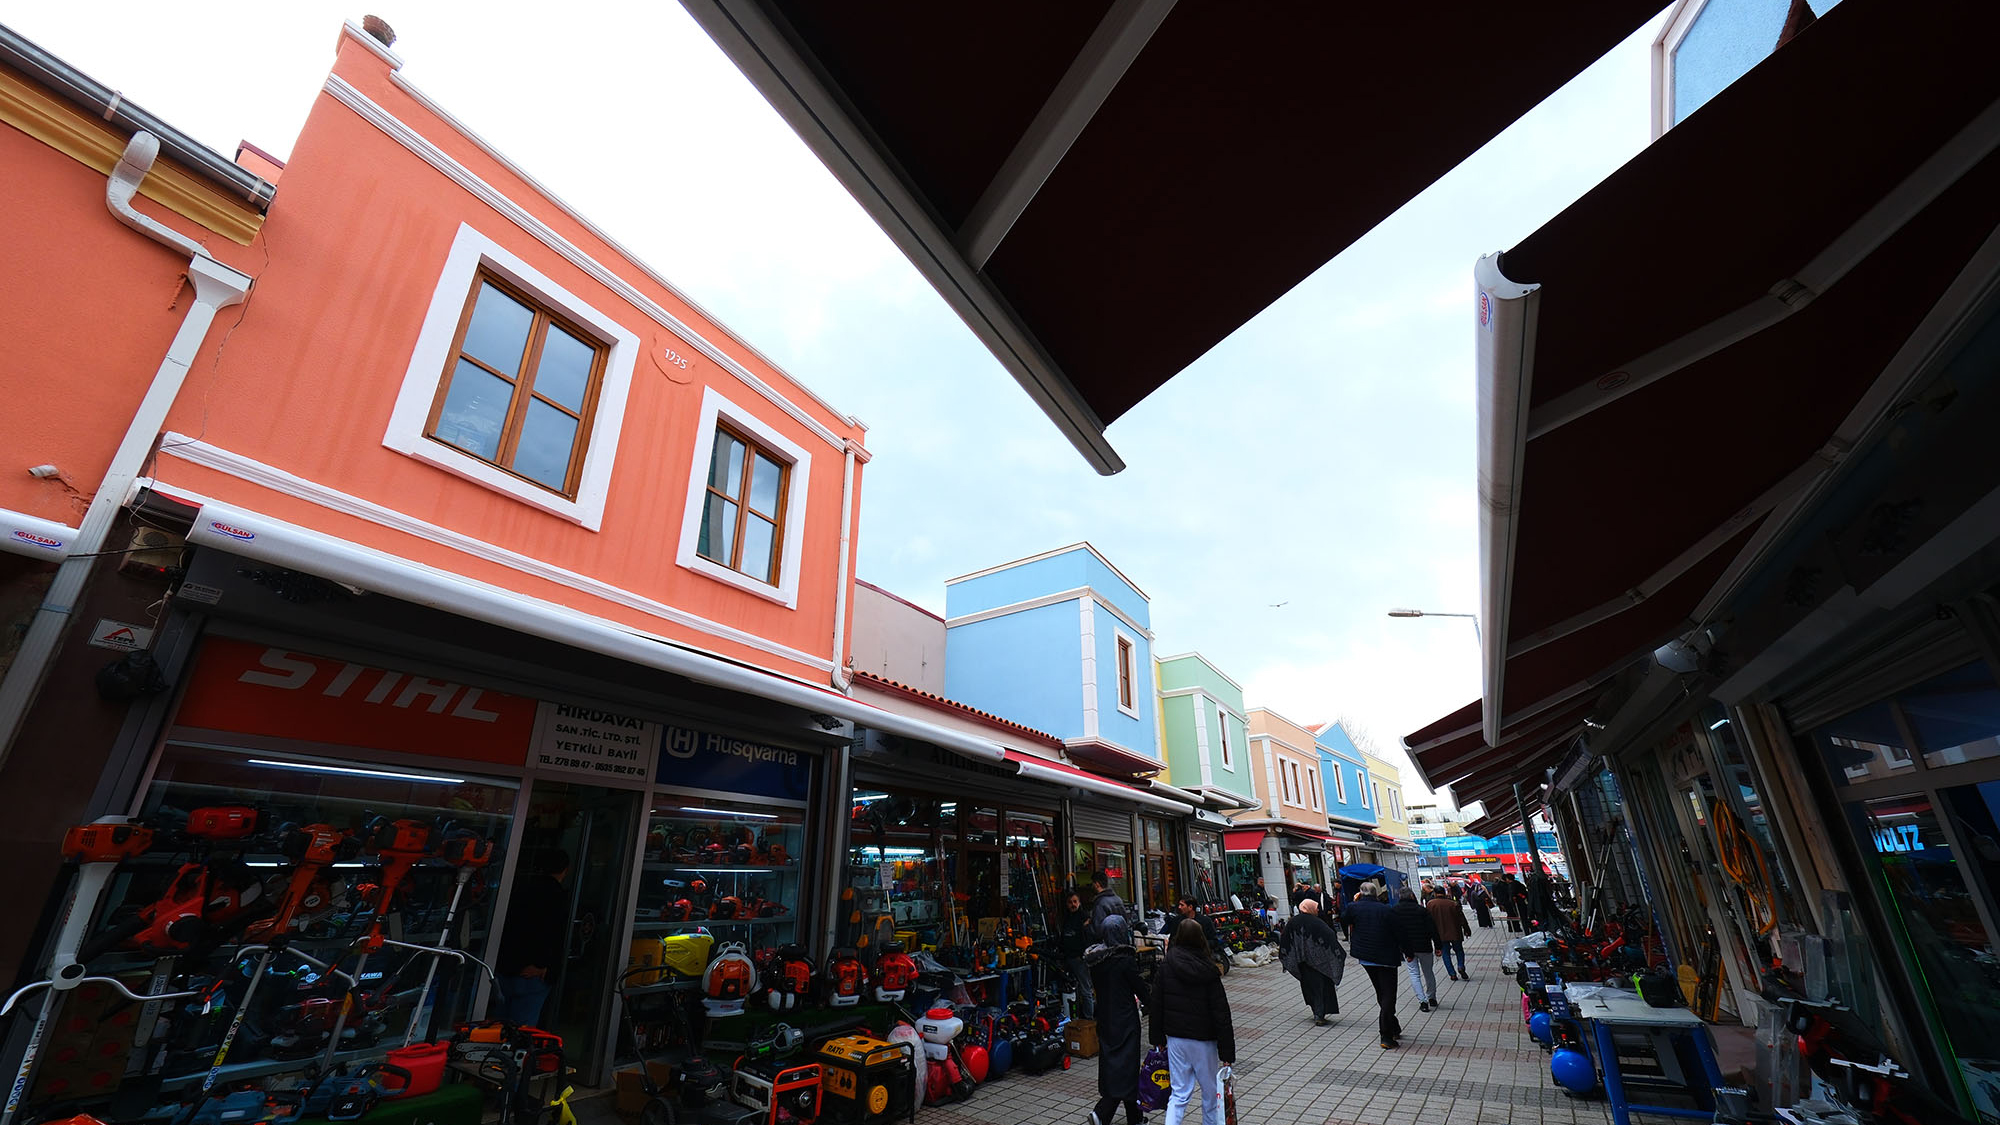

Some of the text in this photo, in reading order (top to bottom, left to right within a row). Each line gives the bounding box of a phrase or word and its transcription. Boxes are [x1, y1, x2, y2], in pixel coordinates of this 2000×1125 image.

[664, 348, 688, 369] 1935
[555, 724, 578, 735] SAN
[706, 733, 798, 766] Husqvarna
[1869, 824, 1925, 852] VOLTZ
[826, 1045, 845, 1055] RATO
